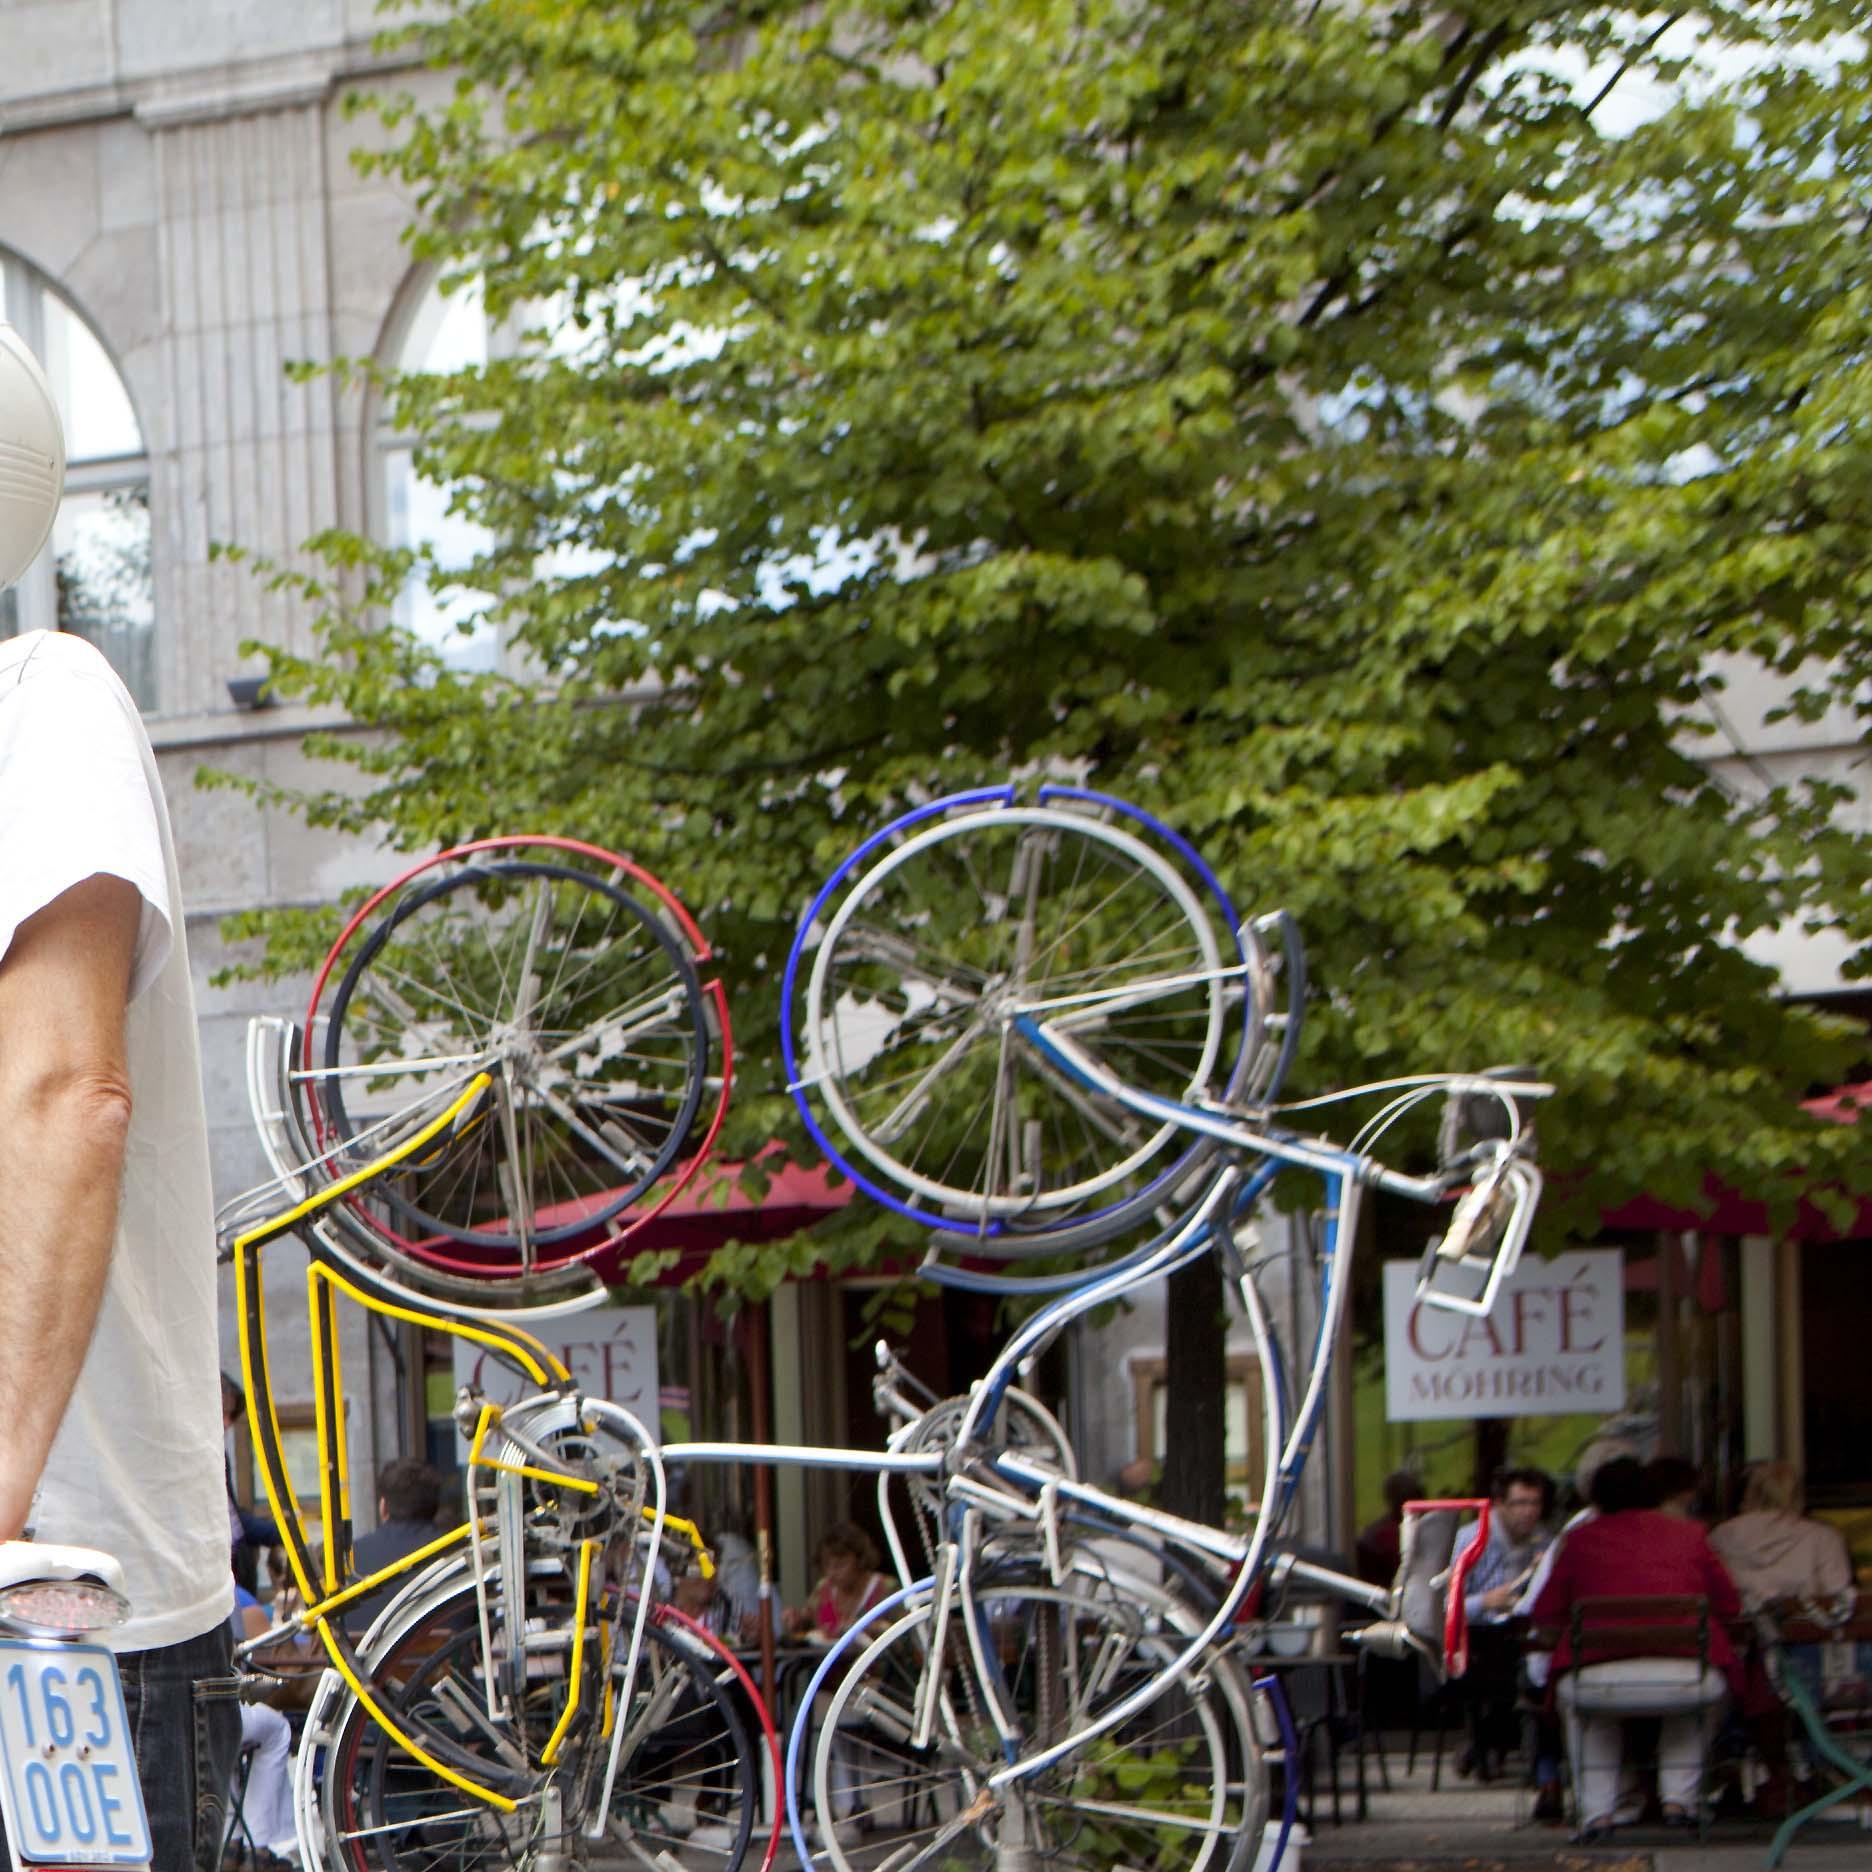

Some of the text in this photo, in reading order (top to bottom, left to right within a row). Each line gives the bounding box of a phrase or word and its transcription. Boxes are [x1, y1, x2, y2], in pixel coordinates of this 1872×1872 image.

[1409, 1265, 1603, 1362] CAFÉ
[1411, 1362, 1604, 1401] MÖHRING
[7, 1663, 112, 1749] 163
